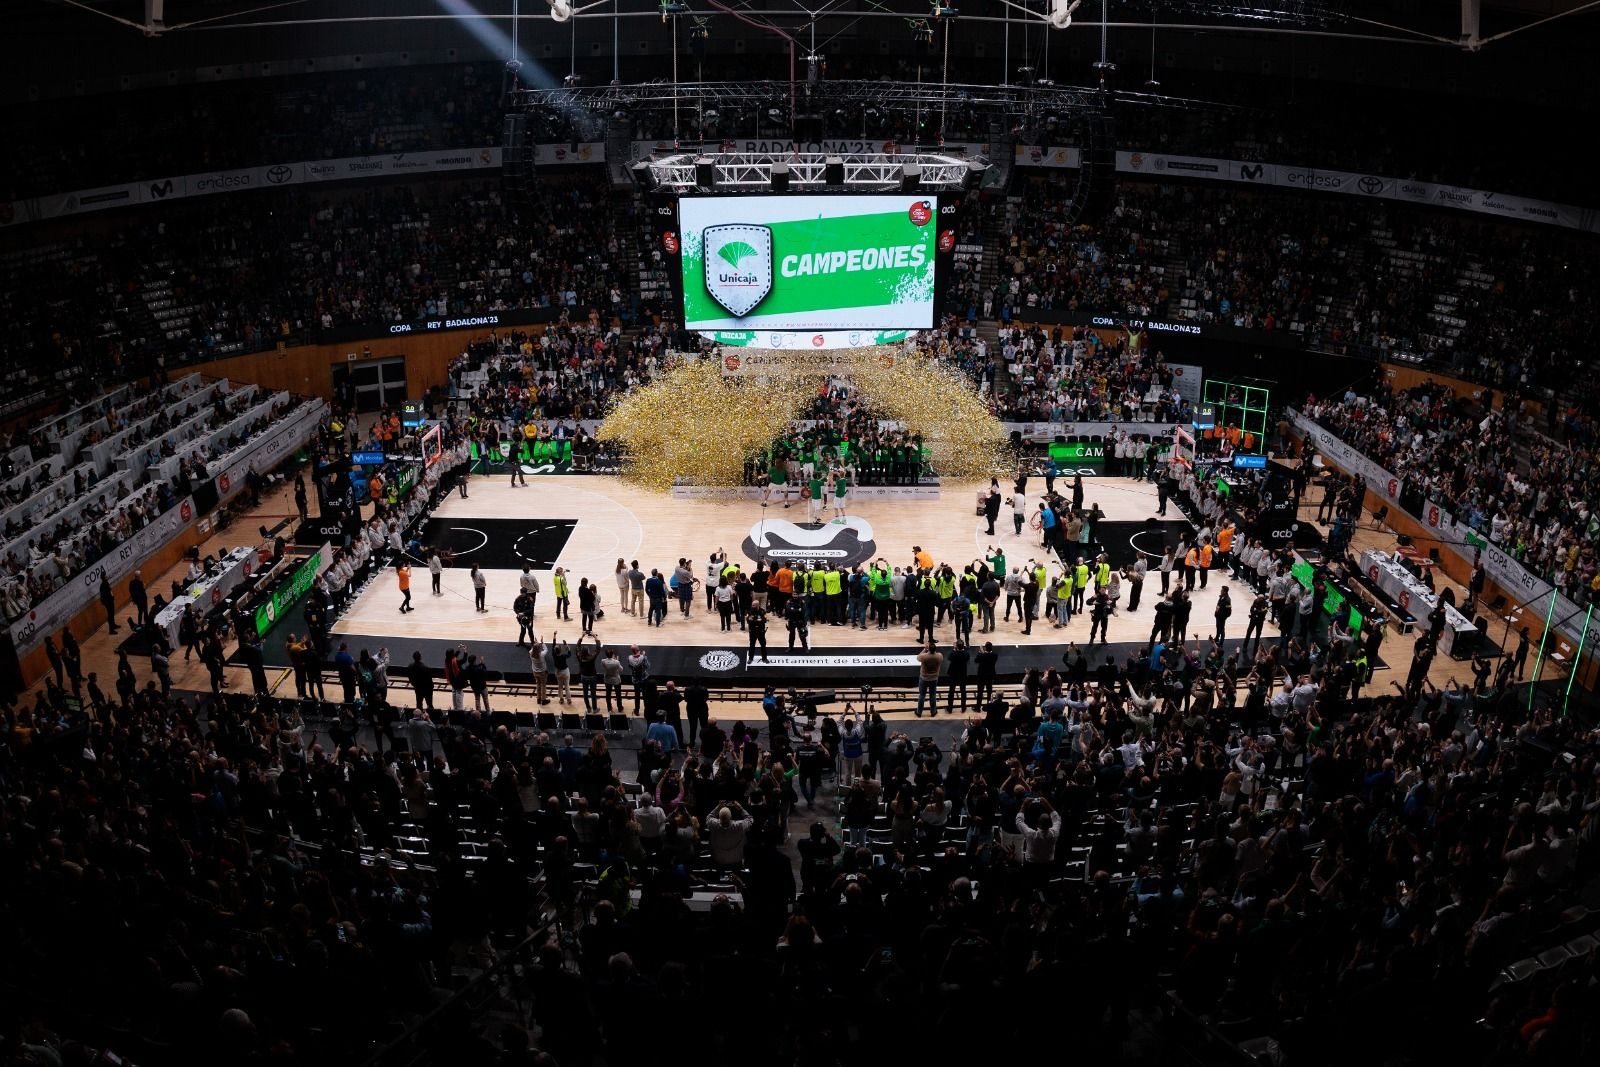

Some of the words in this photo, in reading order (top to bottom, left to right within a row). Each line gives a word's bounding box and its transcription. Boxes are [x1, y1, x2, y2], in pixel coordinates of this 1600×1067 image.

[198, 173, 250, 190] endesa
[1287, 172, 1341, 187] endesa
[658, 206, 672, 216] acb
[941, 204, 956, 214] acb
[781, 243, 926, 279] CAMPEONES
[719, 272, 759, 285] Unicaja
[390, 324, 411, 333] COPA
[427, 320, 442, 329] REY
[445, 315, 499, 327] BADALONA'23
[1092, 317, 1114, 325] COPA
[1148, 322, 1201, 334] BADALONA'23
[266, 440, 280, 455] COPA
[1320, 433, 1334, 449] COPA
[329, 499, 340, 507] acb
[320, 525, 341, 535] acb
[1271, 529, 1293, 538] acb
[84, 565, 106, 586] COPA
[119, 543, 133, 561] REY
[1488, 548, 1508, 570] COPA
[1521, 573, 1538, 593] REY
[17, 621, 36, 641] acb
